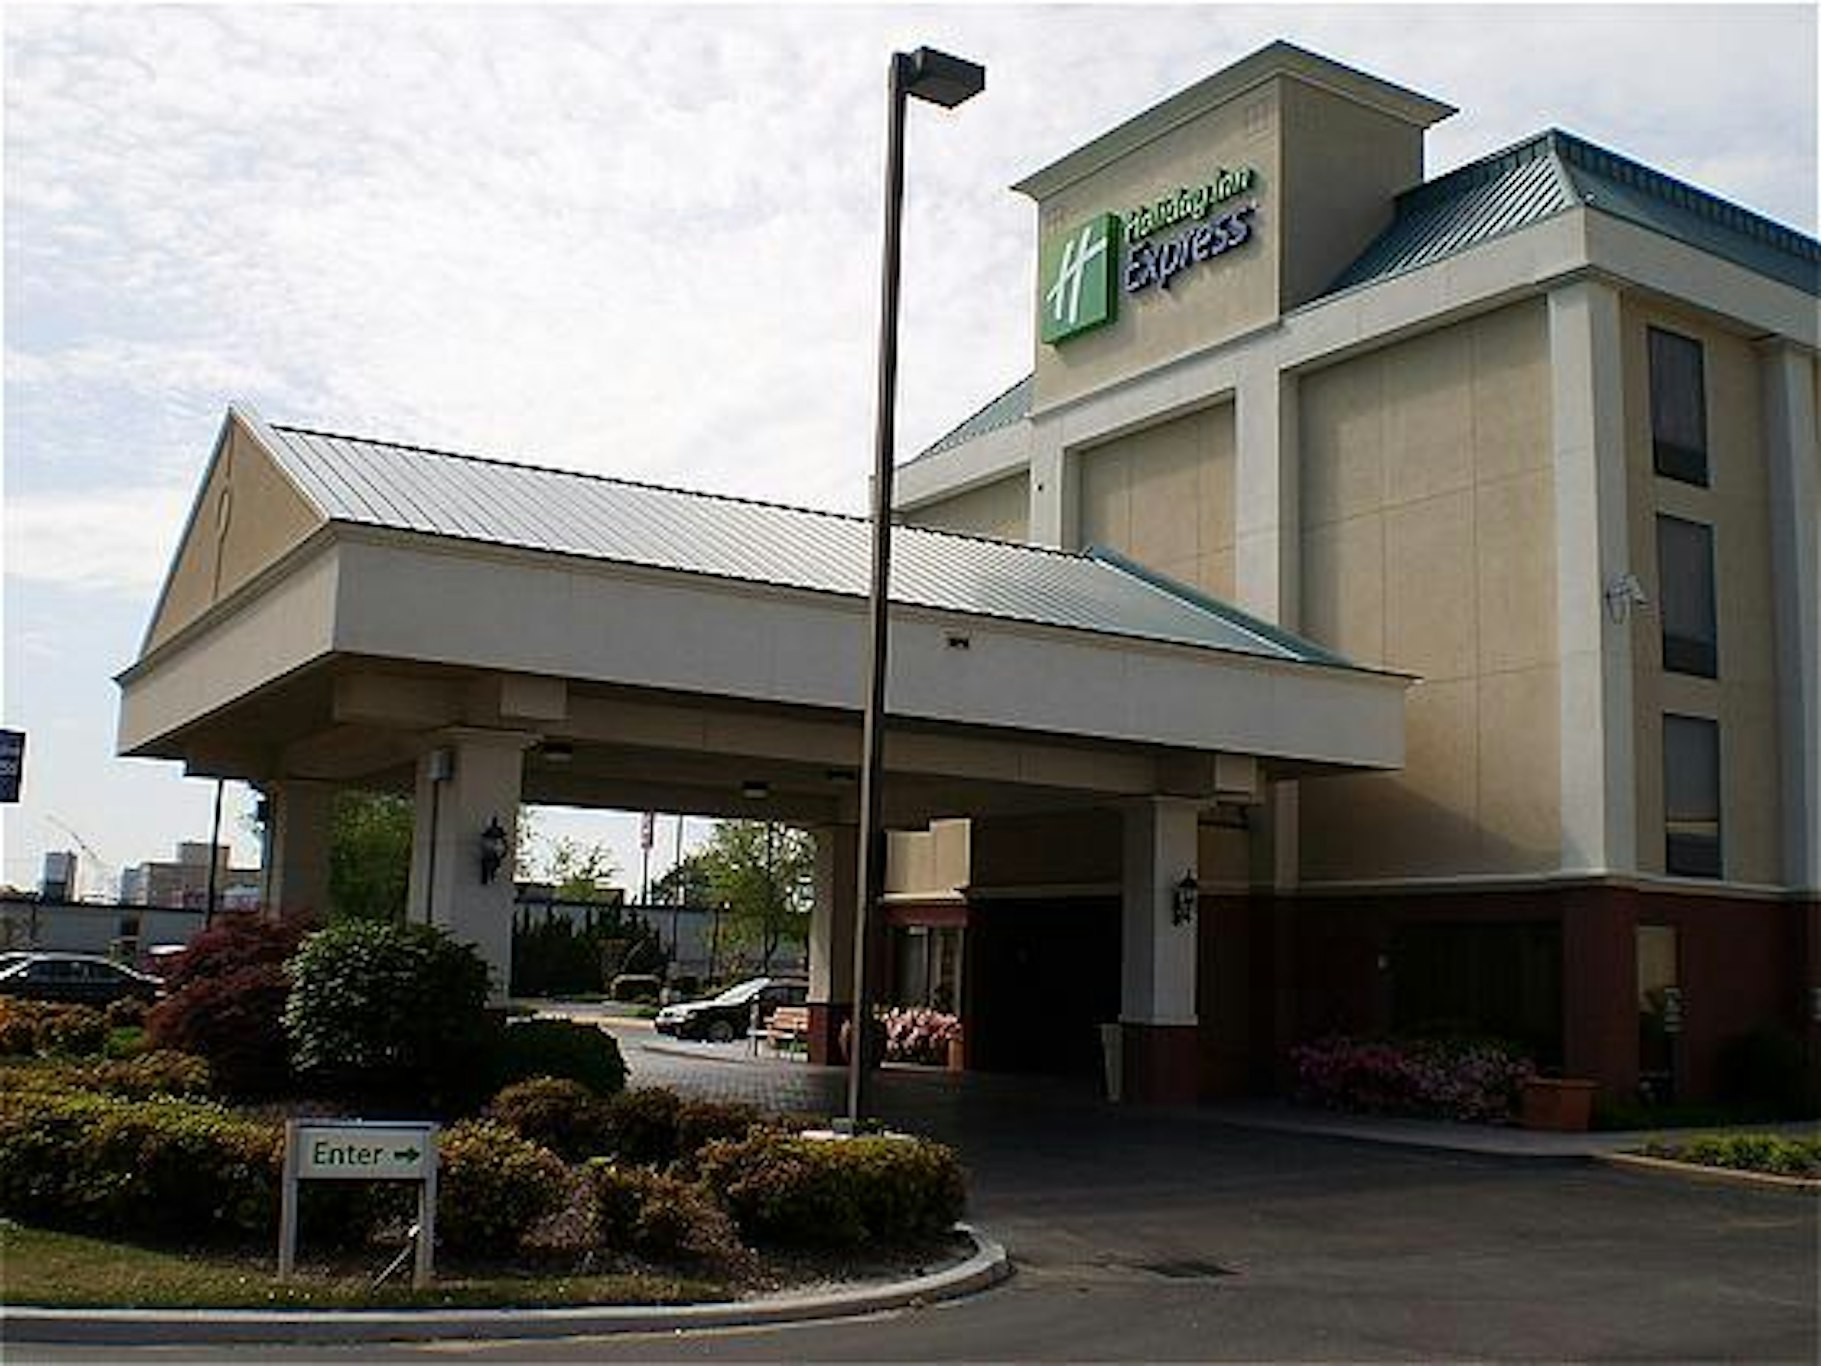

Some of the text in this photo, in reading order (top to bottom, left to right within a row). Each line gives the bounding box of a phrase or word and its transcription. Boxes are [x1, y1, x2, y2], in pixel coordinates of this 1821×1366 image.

[1124, 167, 1256, 243] Holiday Inn
[1124, 206, 1255, 290] Express
[313, 1141, 383, 1165] Enter
